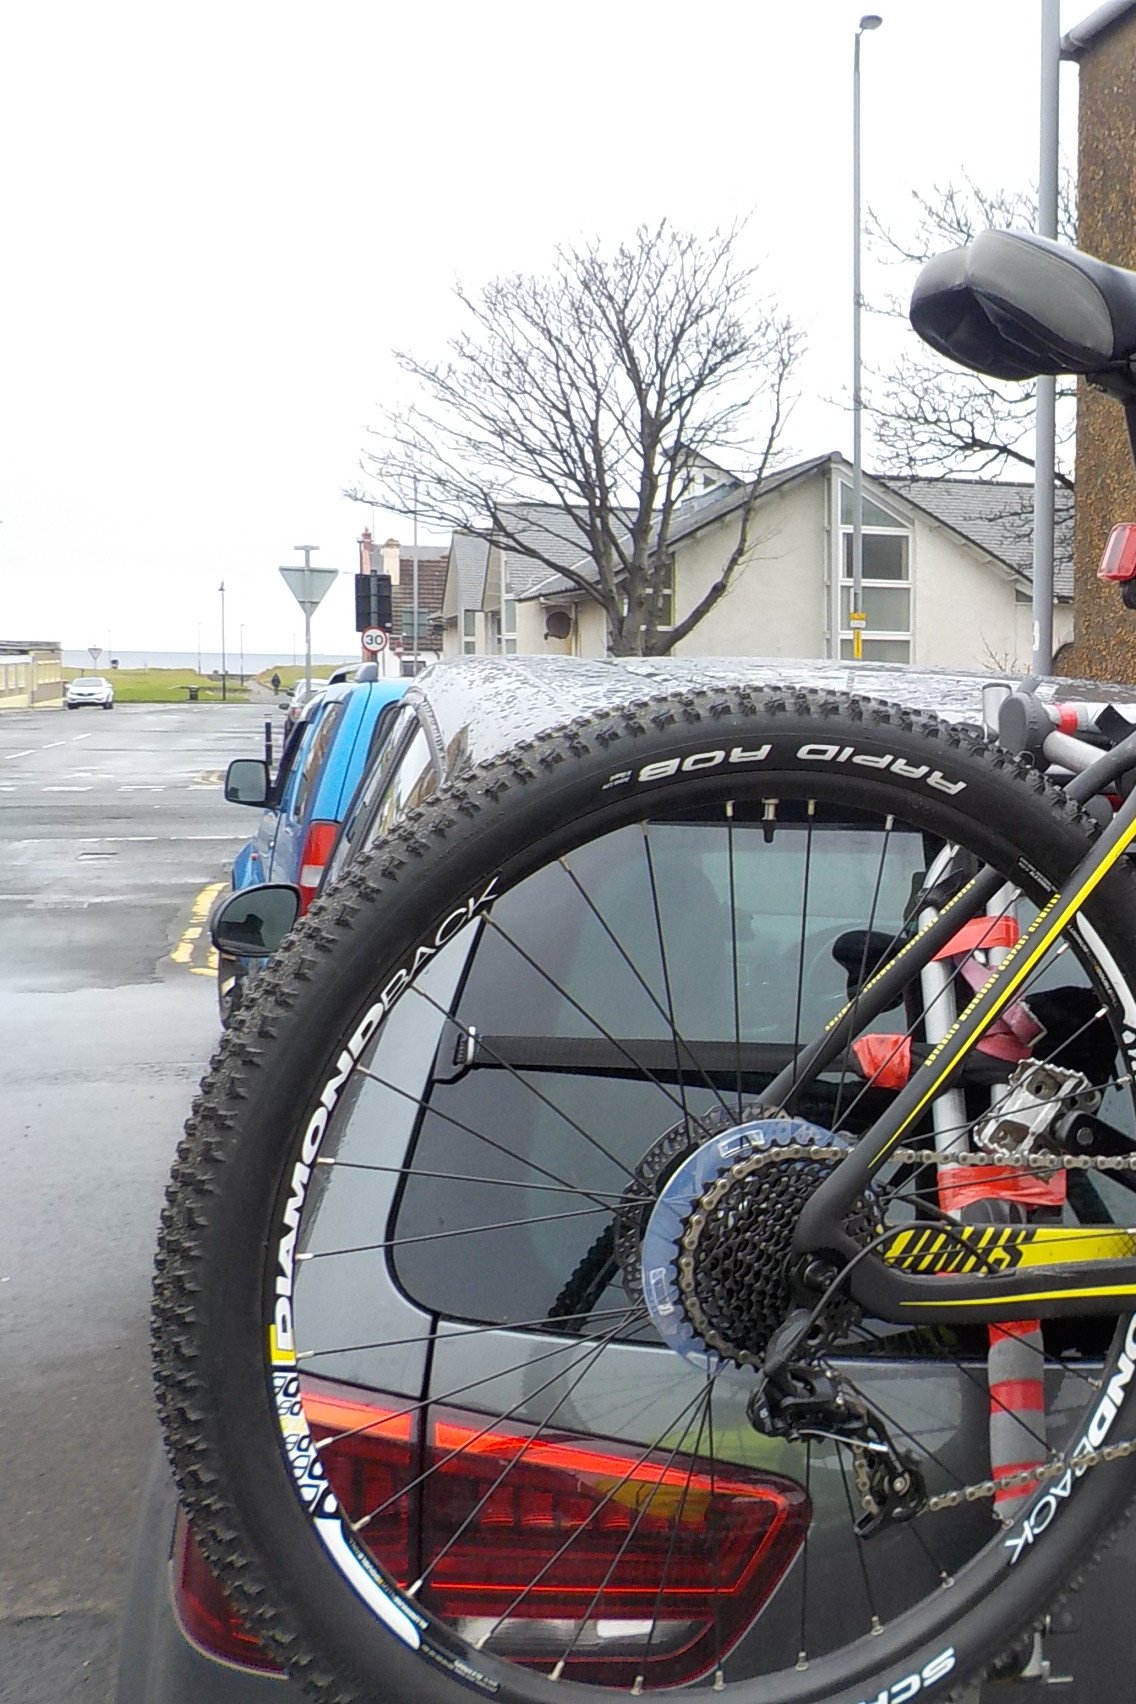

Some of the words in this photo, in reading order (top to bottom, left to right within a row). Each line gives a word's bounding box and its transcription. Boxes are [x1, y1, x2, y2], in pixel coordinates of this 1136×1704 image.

[365, 634, 384, 646] 30
[638, 744, 773, 782] ROB
[796, 743, 968, 795] RAPID
[274, 876, 500, 1352] DIAMONDBACK
